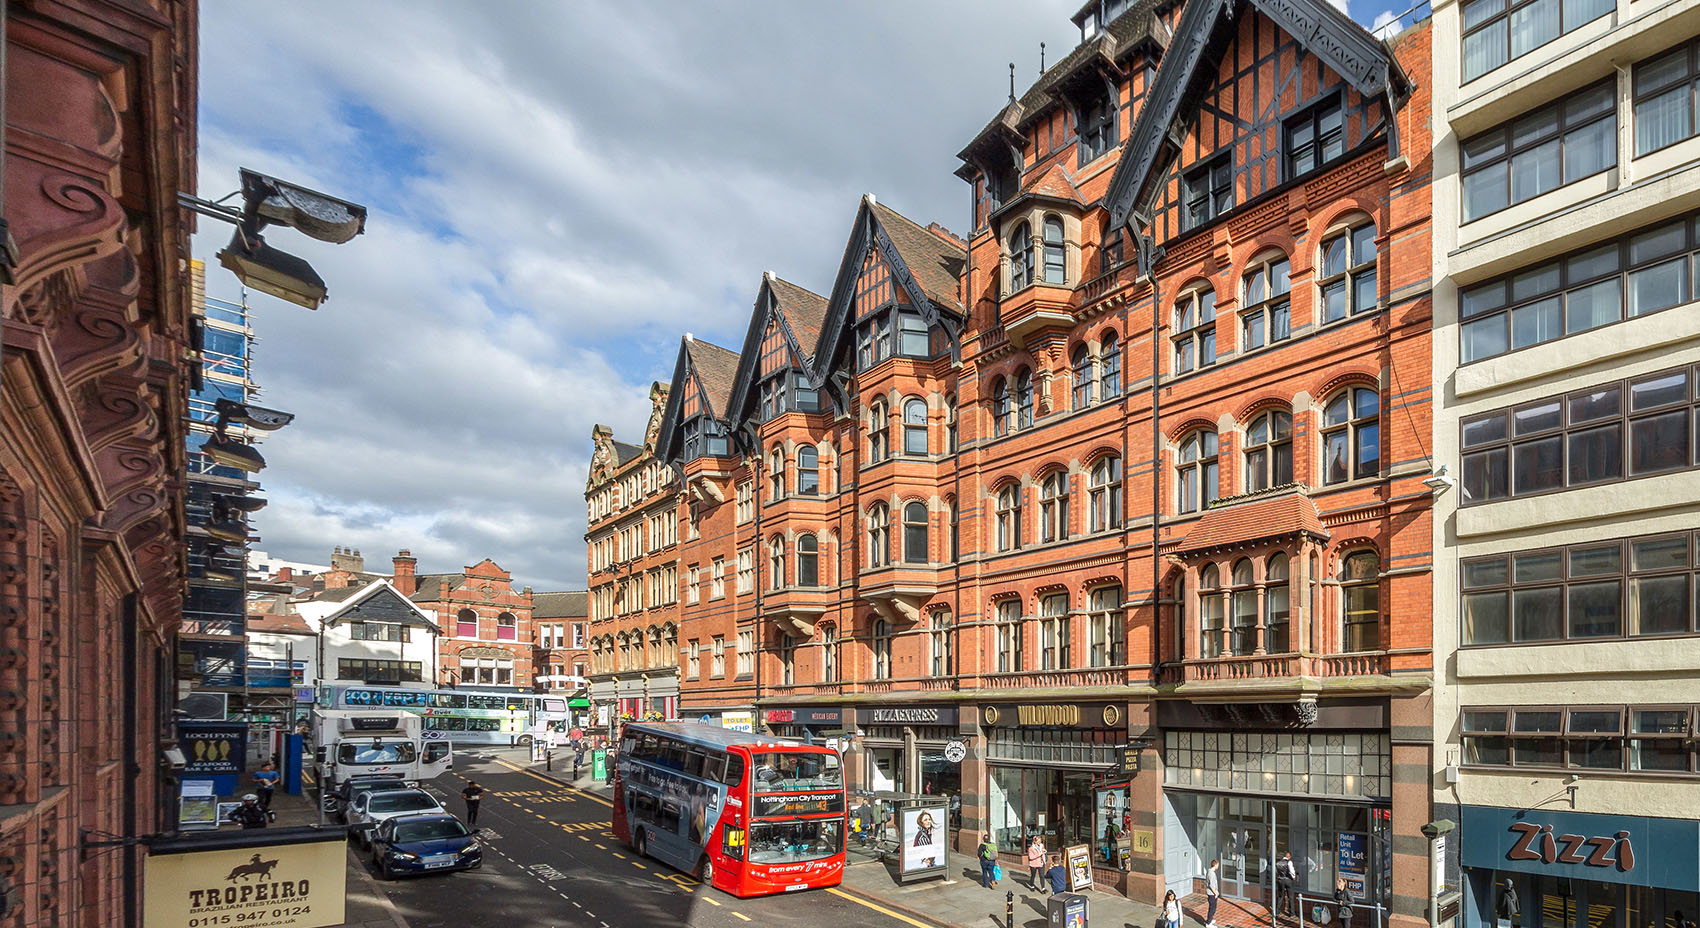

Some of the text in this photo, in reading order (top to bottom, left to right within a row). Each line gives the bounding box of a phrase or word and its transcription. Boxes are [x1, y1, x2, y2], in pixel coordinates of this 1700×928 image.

[1017, 704, 1079, 725] WILDWOOD
[760, 795, 798, 804] Nottingham
[816, 800, 827, 811] 43
[1139, 836, 1149, 848] 16
[1340, 833, 1355, 841] Retail
[1340, 840, 1351, 848] Unit
[1508, 822, 1635, 872] Zizzi
[1340, 849, 1364, 859] To Let
[786, 864, 805, 872] every
[805, 862, 814, 872] 7
[189, 879, 310, 908] TROPEIRO
[190, 896, 309, 914] BRAZILIAN RESTAURANT
[189, 905, 312, 928] 0115 947 0124
